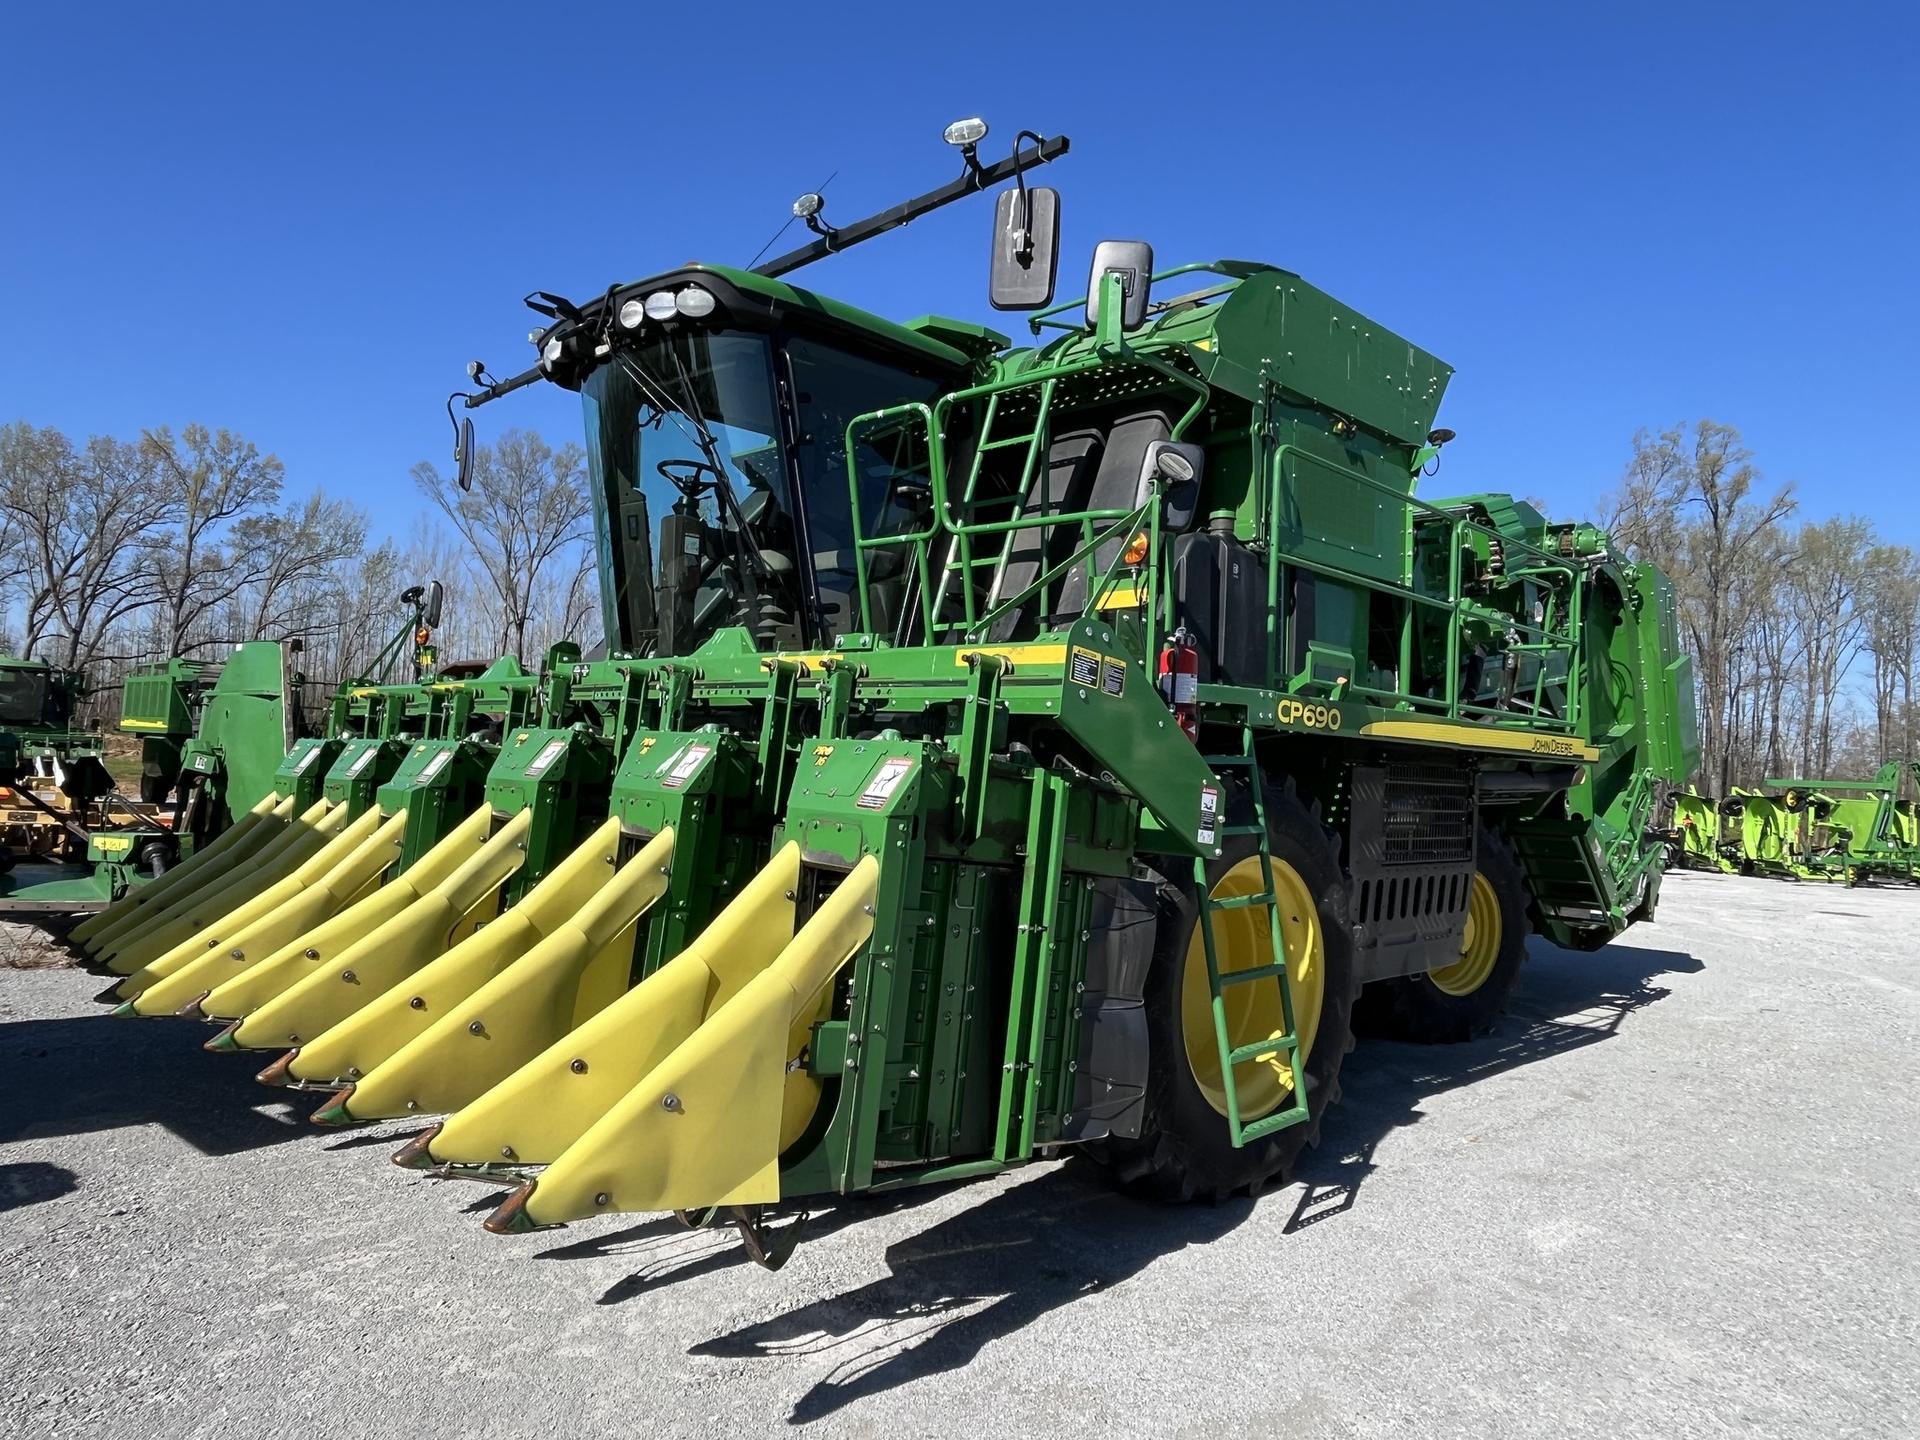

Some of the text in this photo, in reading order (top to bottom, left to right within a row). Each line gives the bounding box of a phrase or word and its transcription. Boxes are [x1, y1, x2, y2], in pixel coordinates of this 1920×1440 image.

[1277, 698, 1342, 731] CP690
[812, 745, 834, 756] PRO
[1531, 737, 1551, 752] JOHN
